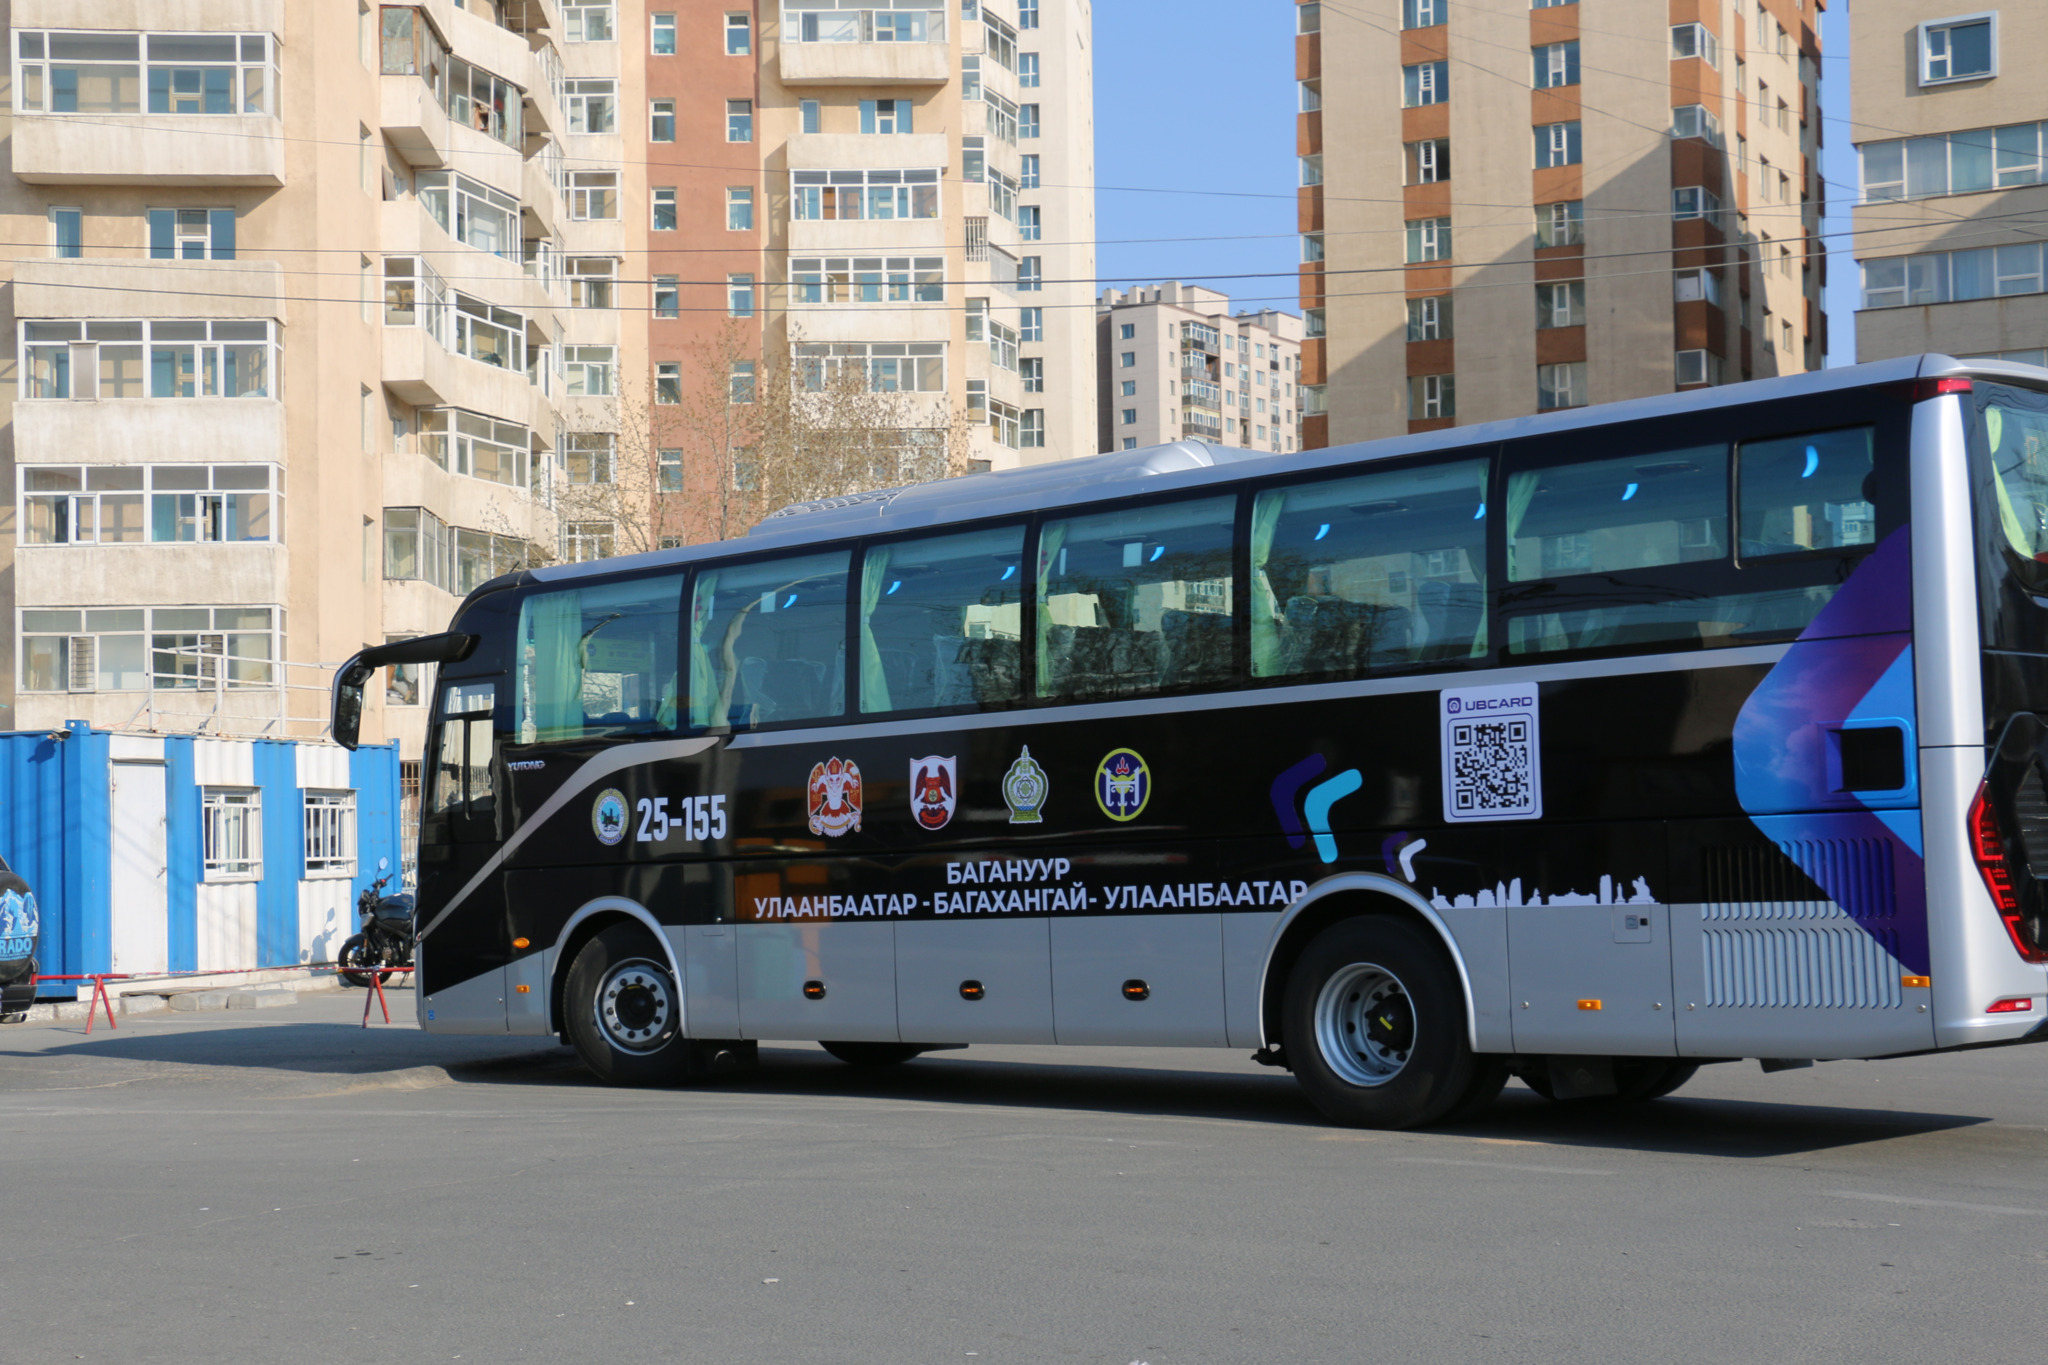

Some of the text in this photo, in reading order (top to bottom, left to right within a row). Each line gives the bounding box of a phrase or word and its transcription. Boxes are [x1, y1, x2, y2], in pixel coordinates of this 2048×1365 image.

[1465, 696, 1533, 711] UBCARD
[507, 760, 546, 771] YUTONG
[636, 793, 728, 842] 25-155
[946, 857, 1070, 885] БАГАНУУР
[753, 893, 918, 919] УЛААНБААТАР
[1103, 880, 1309, 910] УЛААНБААТАР
